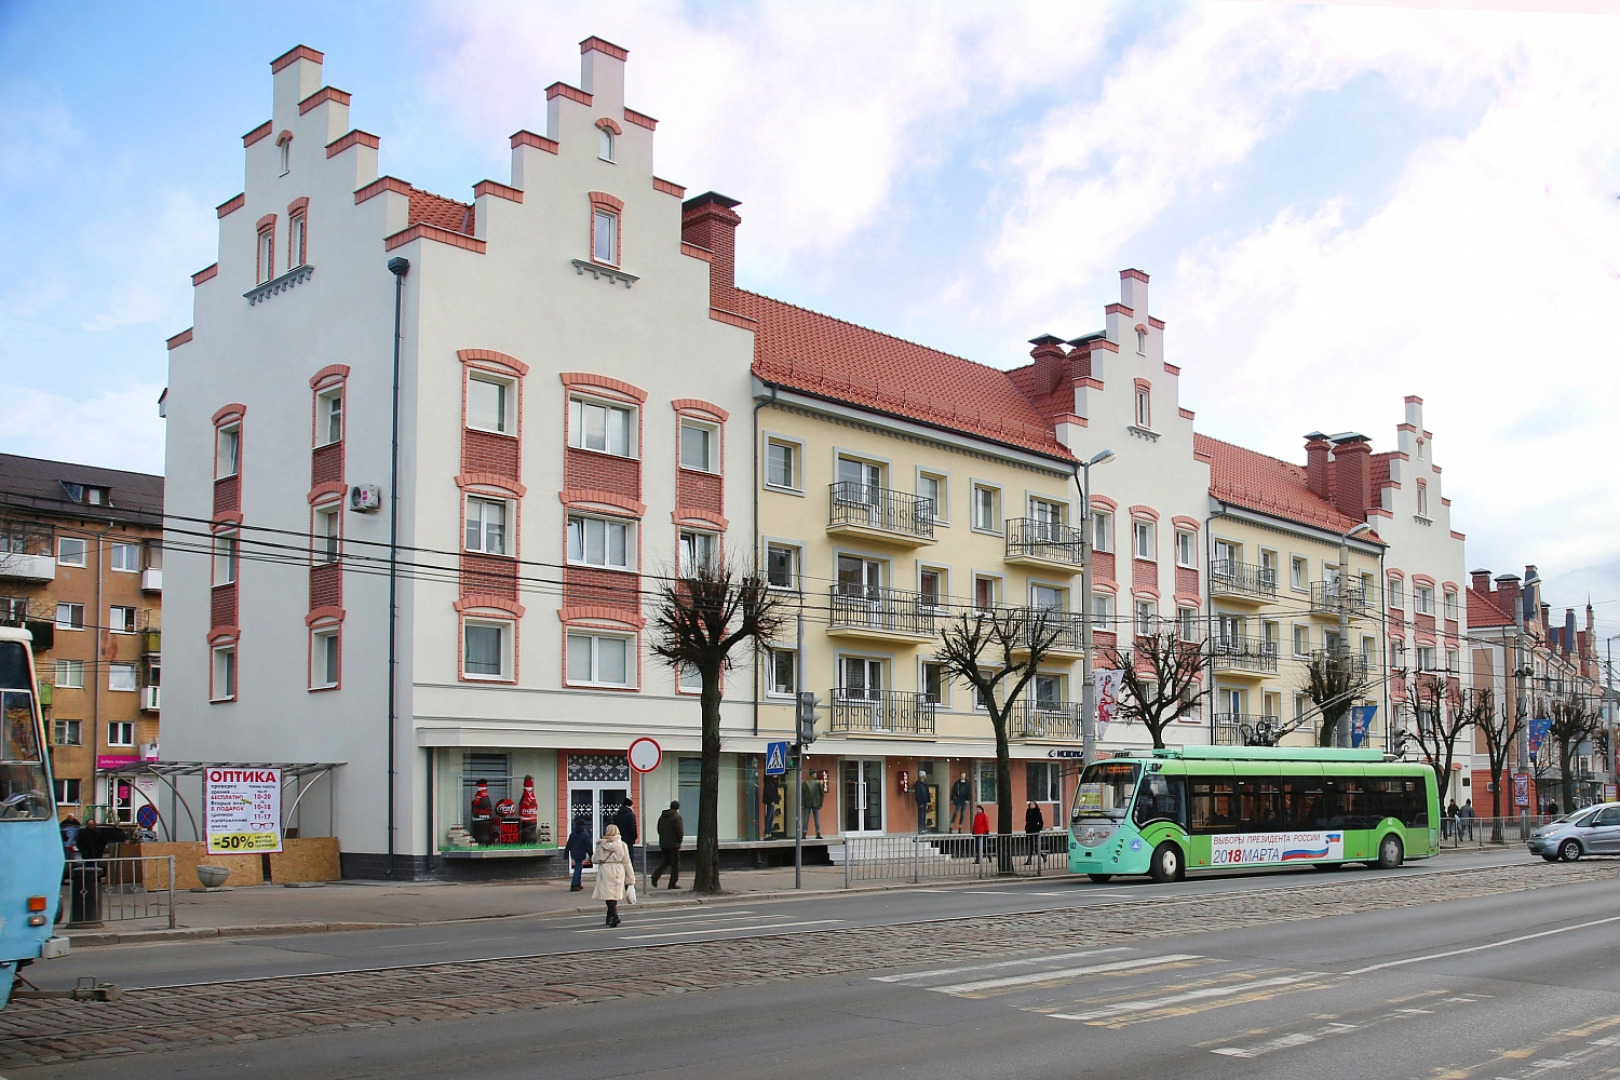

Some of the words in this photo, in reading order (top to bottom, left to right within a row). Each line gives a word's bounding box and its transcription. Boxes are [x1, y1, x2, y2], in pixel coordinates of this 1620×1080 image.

[210, 770, 276, 783] ОПТИКА
[502, 824, 519, 832] RUS
[214, 836, 254, 849] -50%
[1213, 836, 1245, 845] ВЫБОРЫ
[1247, 834, 1290, 844] ПРЕЗИДЕНТА
[1294, 834, 1320, 842] РОССИИ
